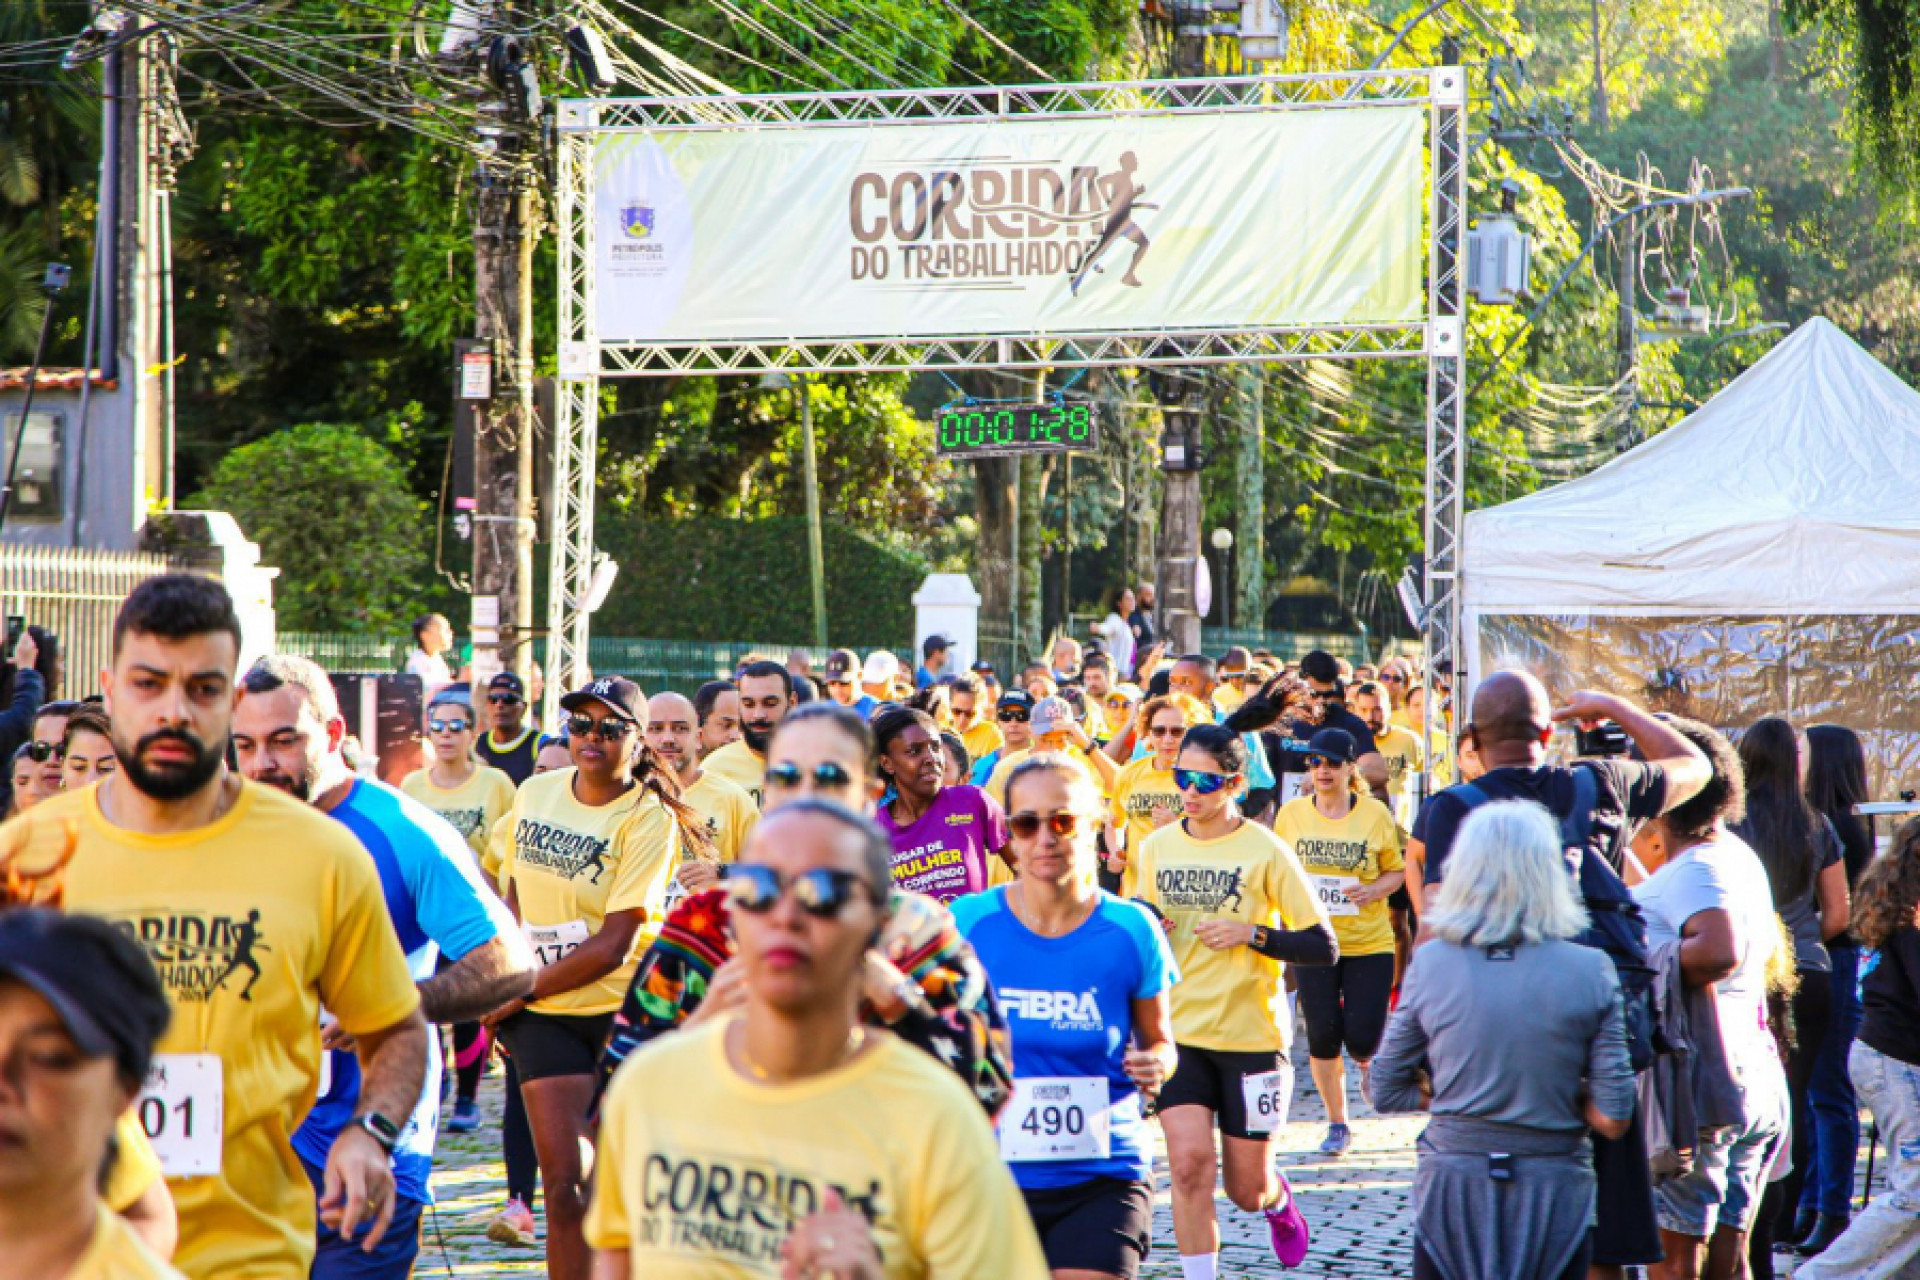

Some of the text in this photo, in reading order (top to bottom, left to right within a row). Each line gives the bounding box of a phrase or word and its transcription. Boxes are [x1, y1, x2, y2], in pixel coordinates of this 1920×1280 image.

[850, 165, 1104, 243] CORRIDA
[851, 245, 888, 280] DO
[940, 406, 1090, 448] 00:01:28
[888, 848, 963, 881] MULHER
[998, 987, 1103, 1021] FIBRA
[139, 1095, 193, 1138] 01
[1021, 1105, 1085, 1136] 490
[643, 1153, 847, 1231] CORRID
